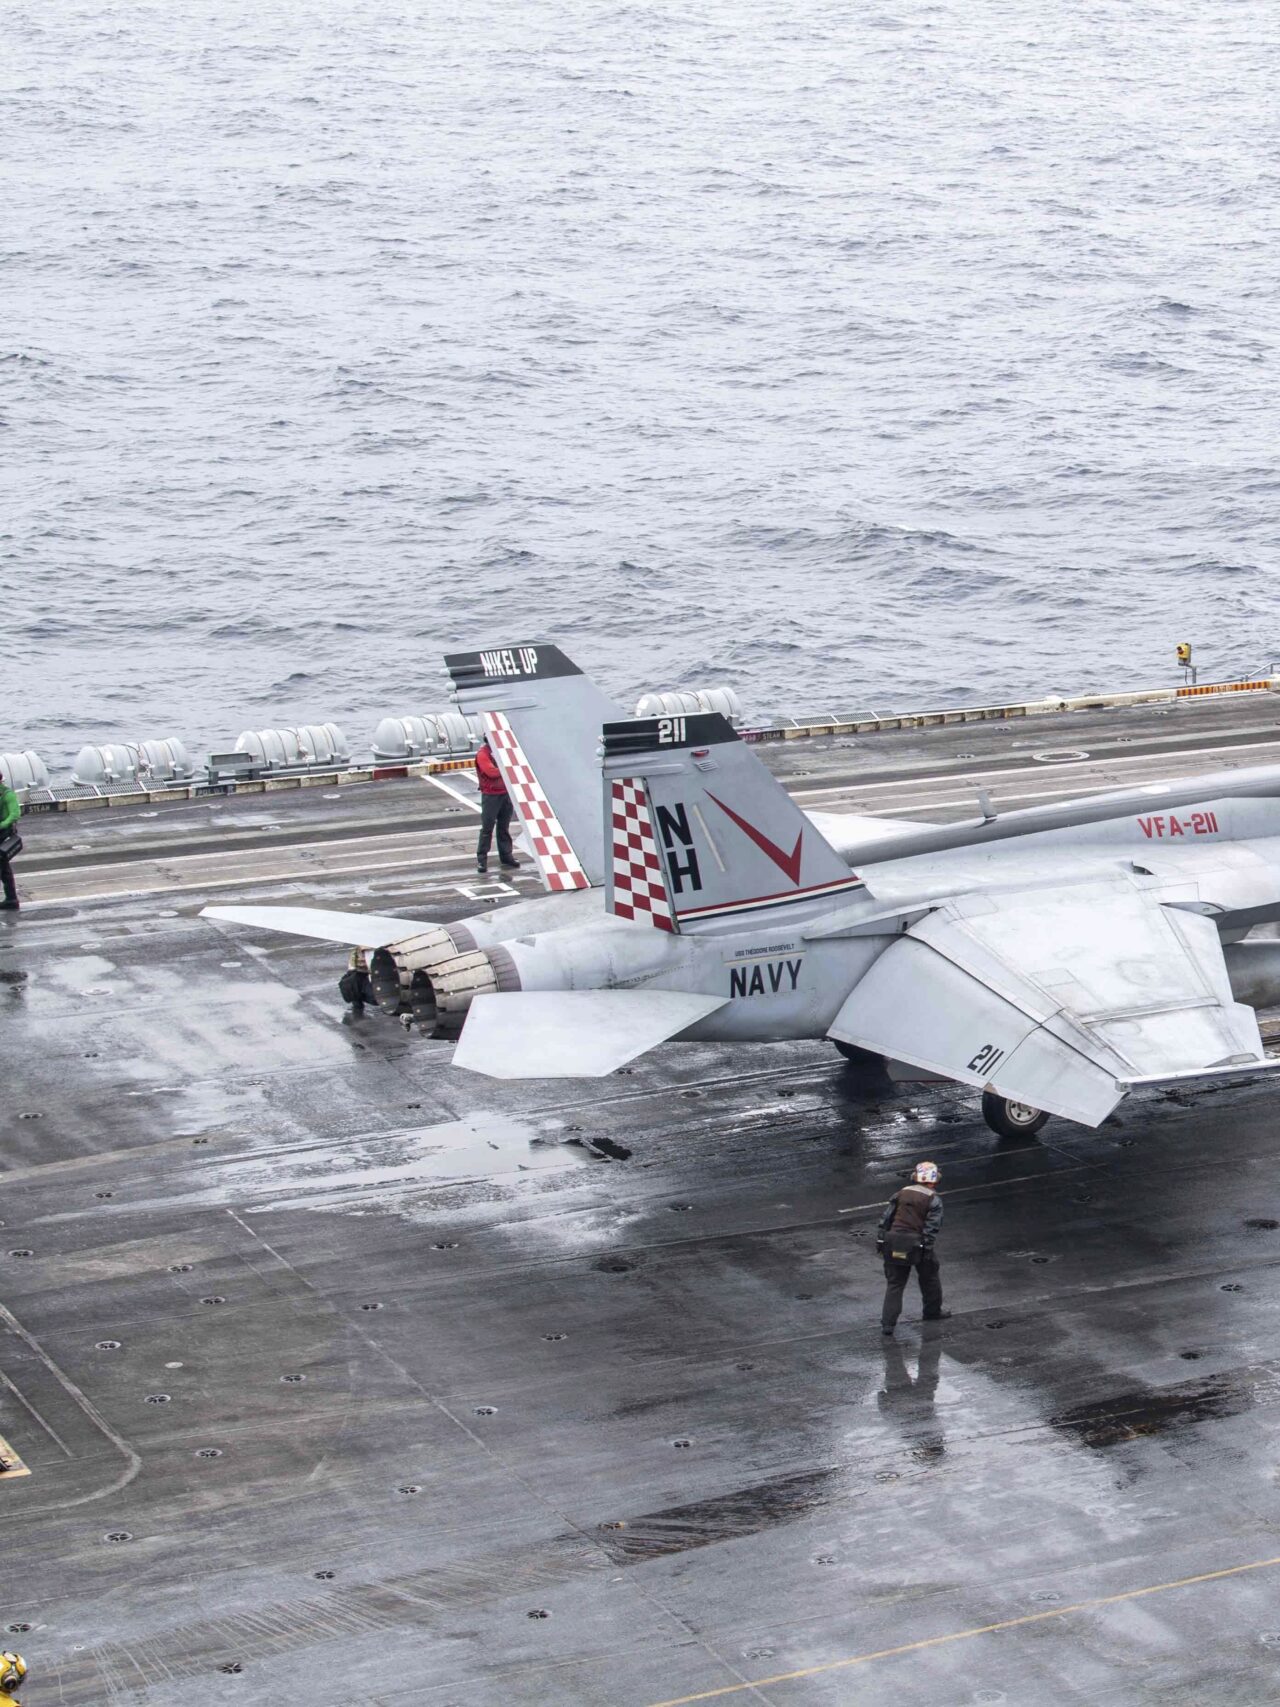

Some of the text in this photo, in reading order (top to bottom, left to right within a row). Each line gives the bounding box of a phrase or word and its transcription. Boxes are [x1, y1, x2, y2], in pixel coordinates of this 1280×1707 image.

[480, 648, 538, 677] NIKEL UP
[658, 718, 686, 743] 211
[1137, 812, 1219, 839] VFA-211
[730, 958, 802, 999] NAVY
[966, 1044, 1005, 1076] 211
